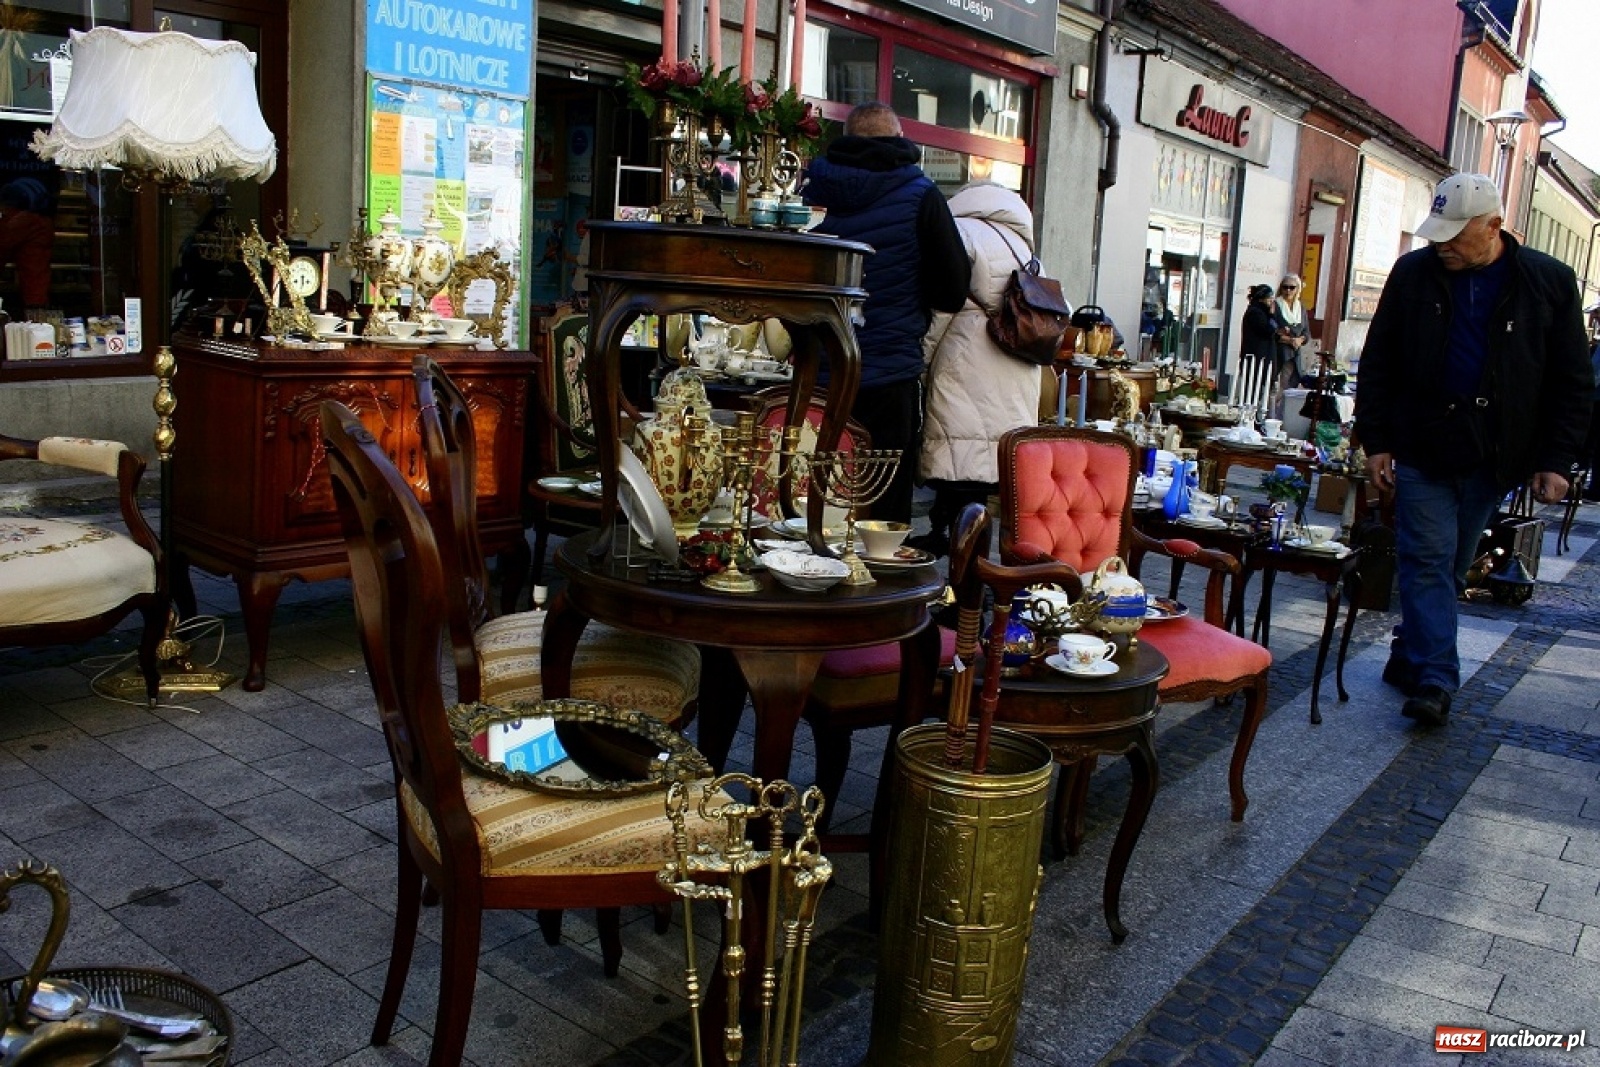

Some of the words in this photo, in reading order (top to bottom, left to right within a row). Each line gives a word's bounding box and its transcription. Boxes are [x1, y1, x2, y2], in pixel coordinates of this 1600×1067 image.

[375, 0, 526, 51] AUTOKAROWE
[395, 42, 402, 71] I
[408, 43, 509, 88] LOTNICZE
